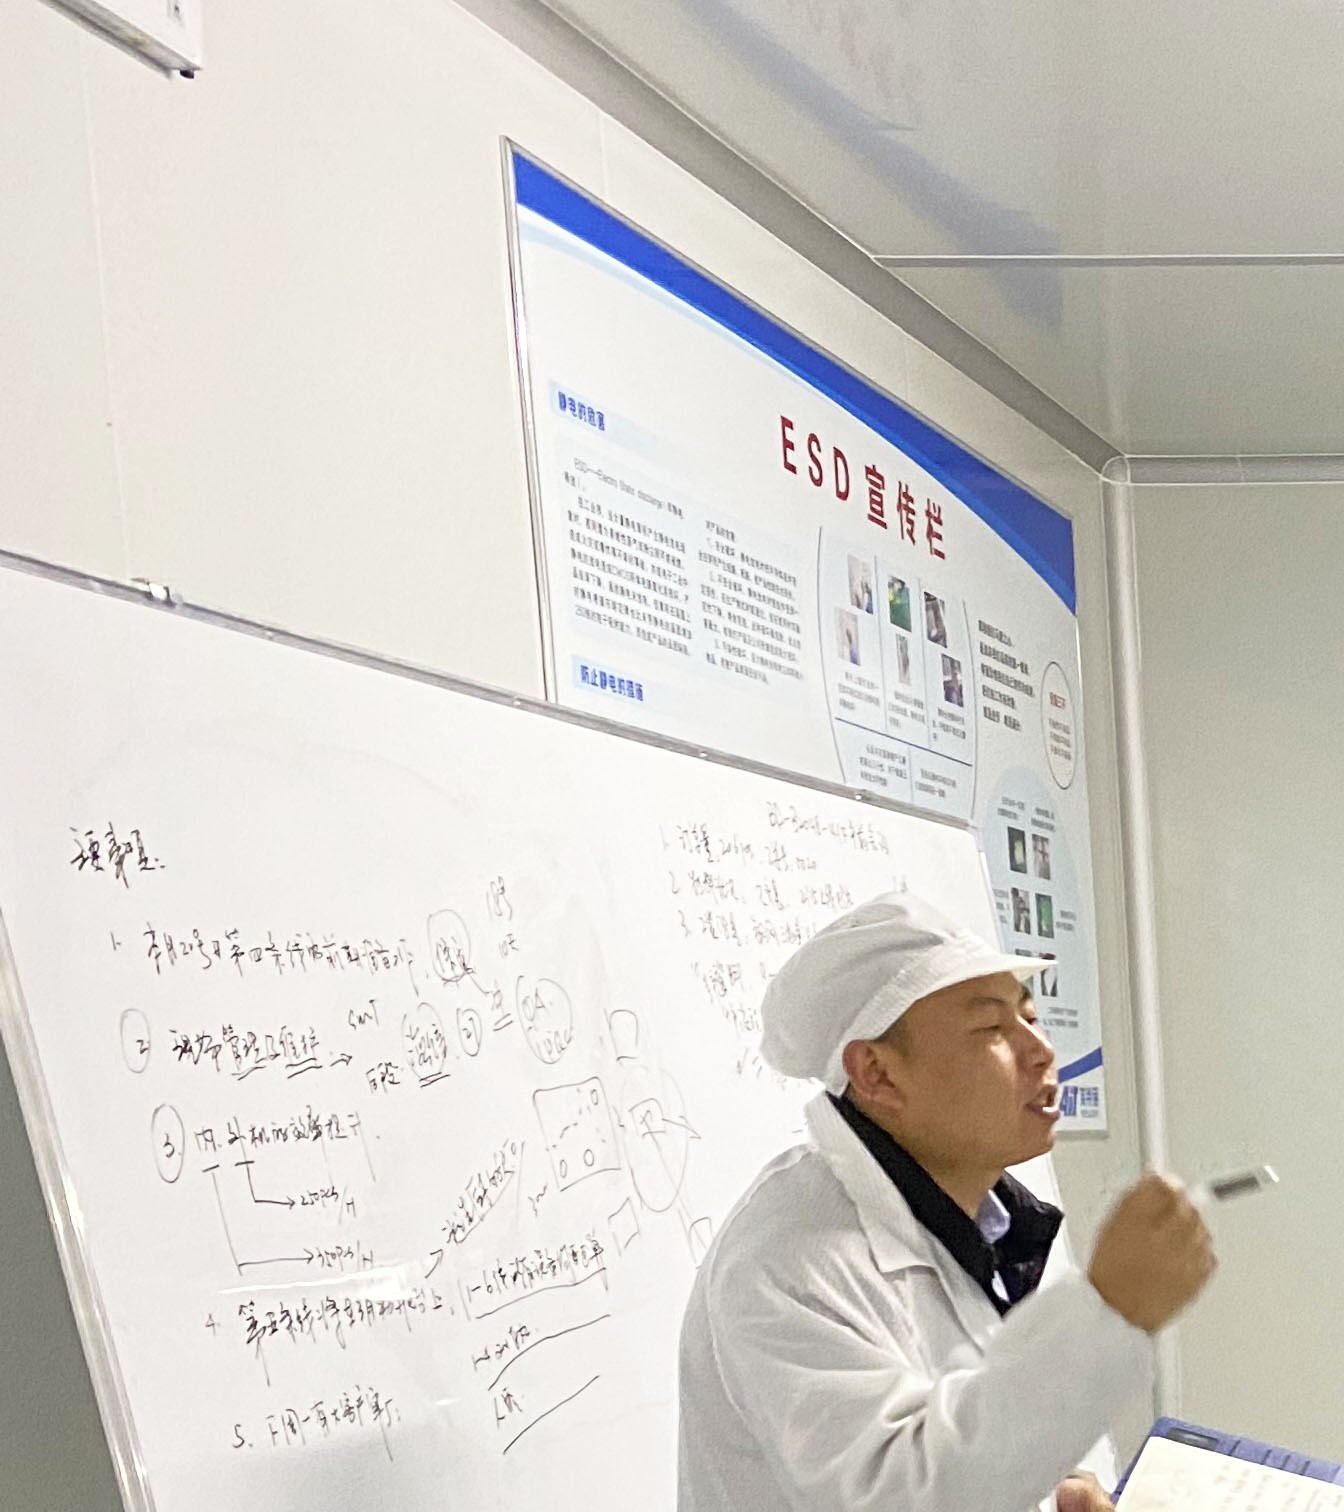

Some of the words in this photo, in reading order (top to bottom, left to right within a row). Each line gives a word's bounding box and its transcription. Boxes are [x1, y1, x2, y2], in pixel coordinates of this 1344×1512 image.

[780, 415, 850, 501] ESD
[864, 464, 947, 561] 宣传栏
